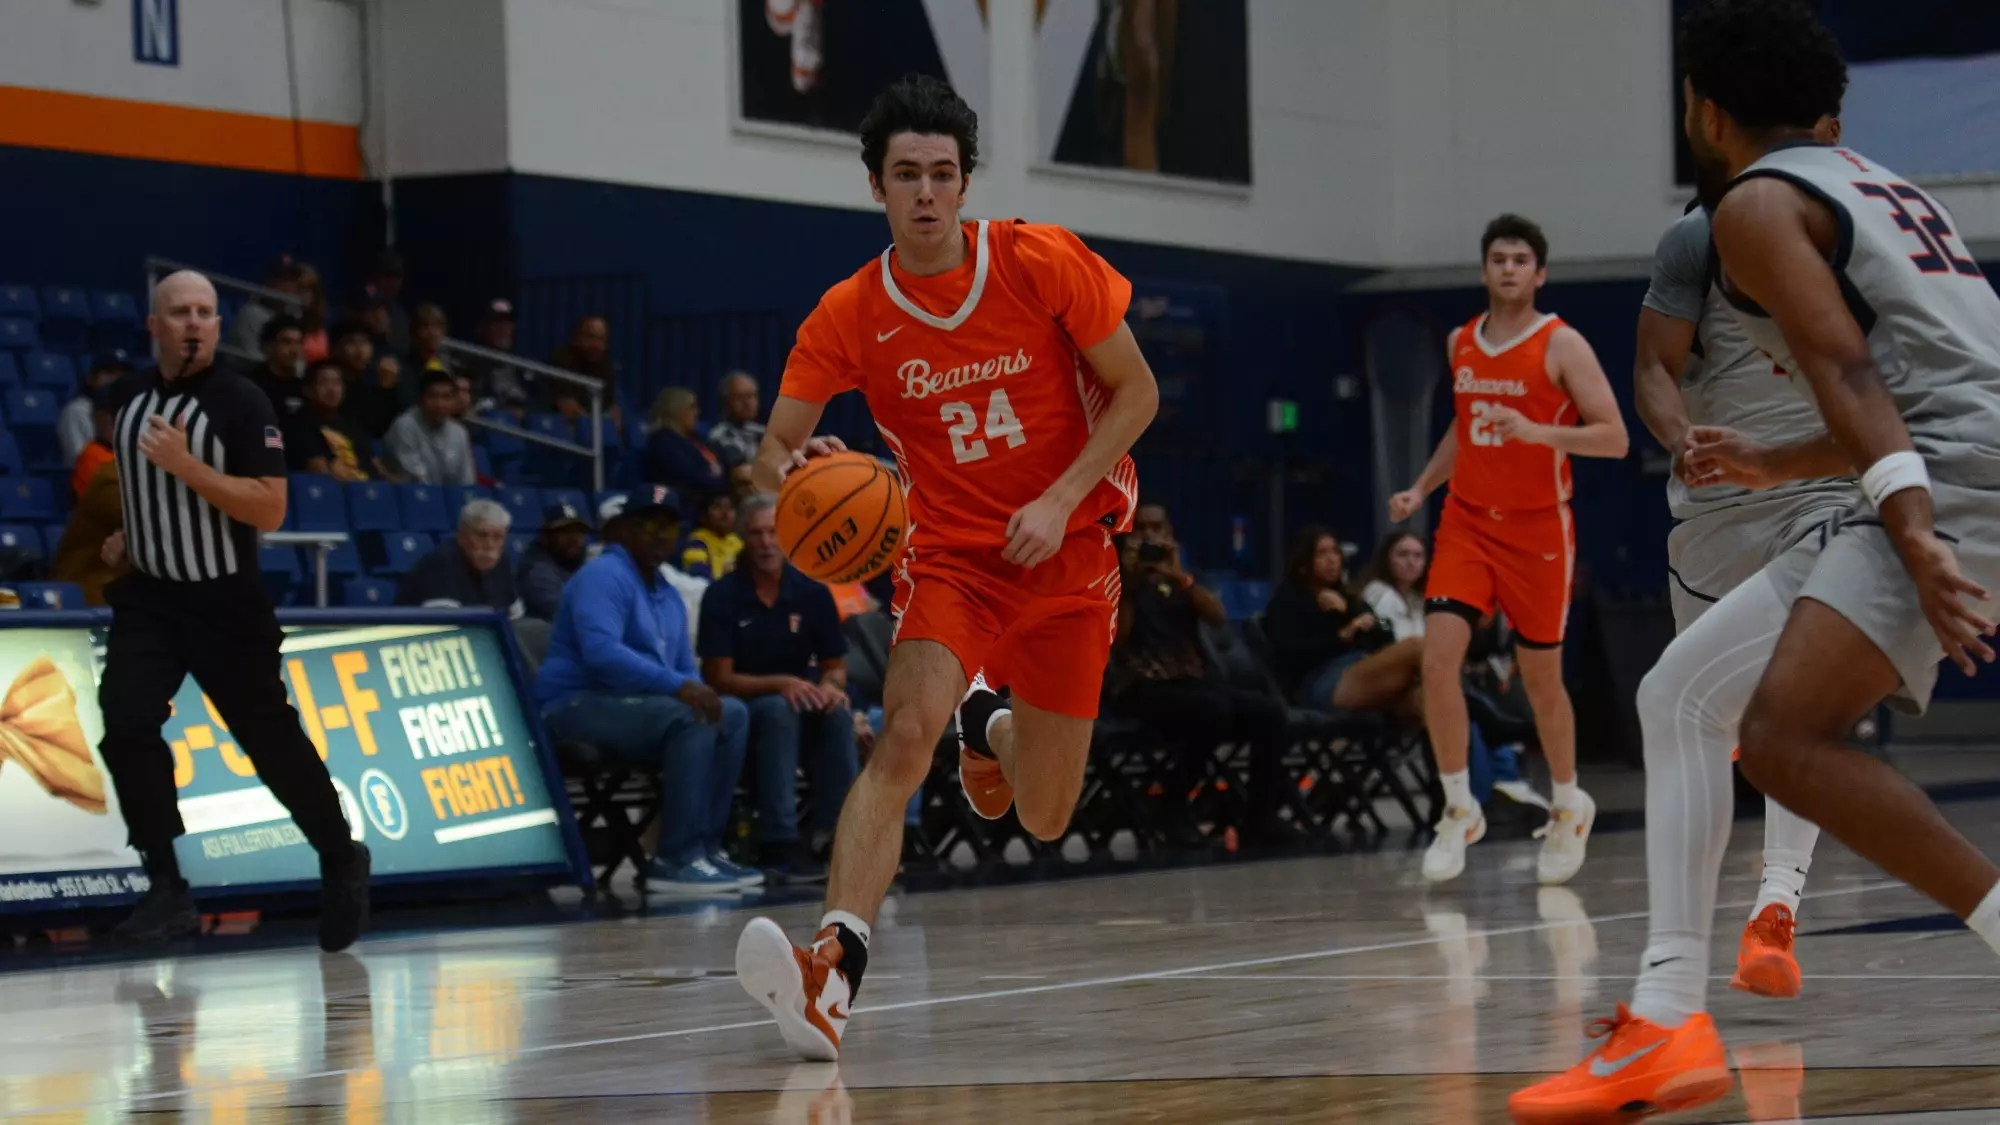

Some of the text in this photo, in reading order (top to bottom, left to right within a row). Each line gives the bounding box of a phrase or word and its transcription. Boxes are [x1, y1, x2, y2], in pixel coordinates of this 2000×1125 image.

[1852, 181, 1987, 279] 32
[896, 348, 1033, 400] Beavers
[939, 387, 1027, 465] 24
[379, 636, 483, 699] FIGHT!
[398, 695, 504, 760] FIGHT!
[421, 755, 525, 820] FIGHT!
